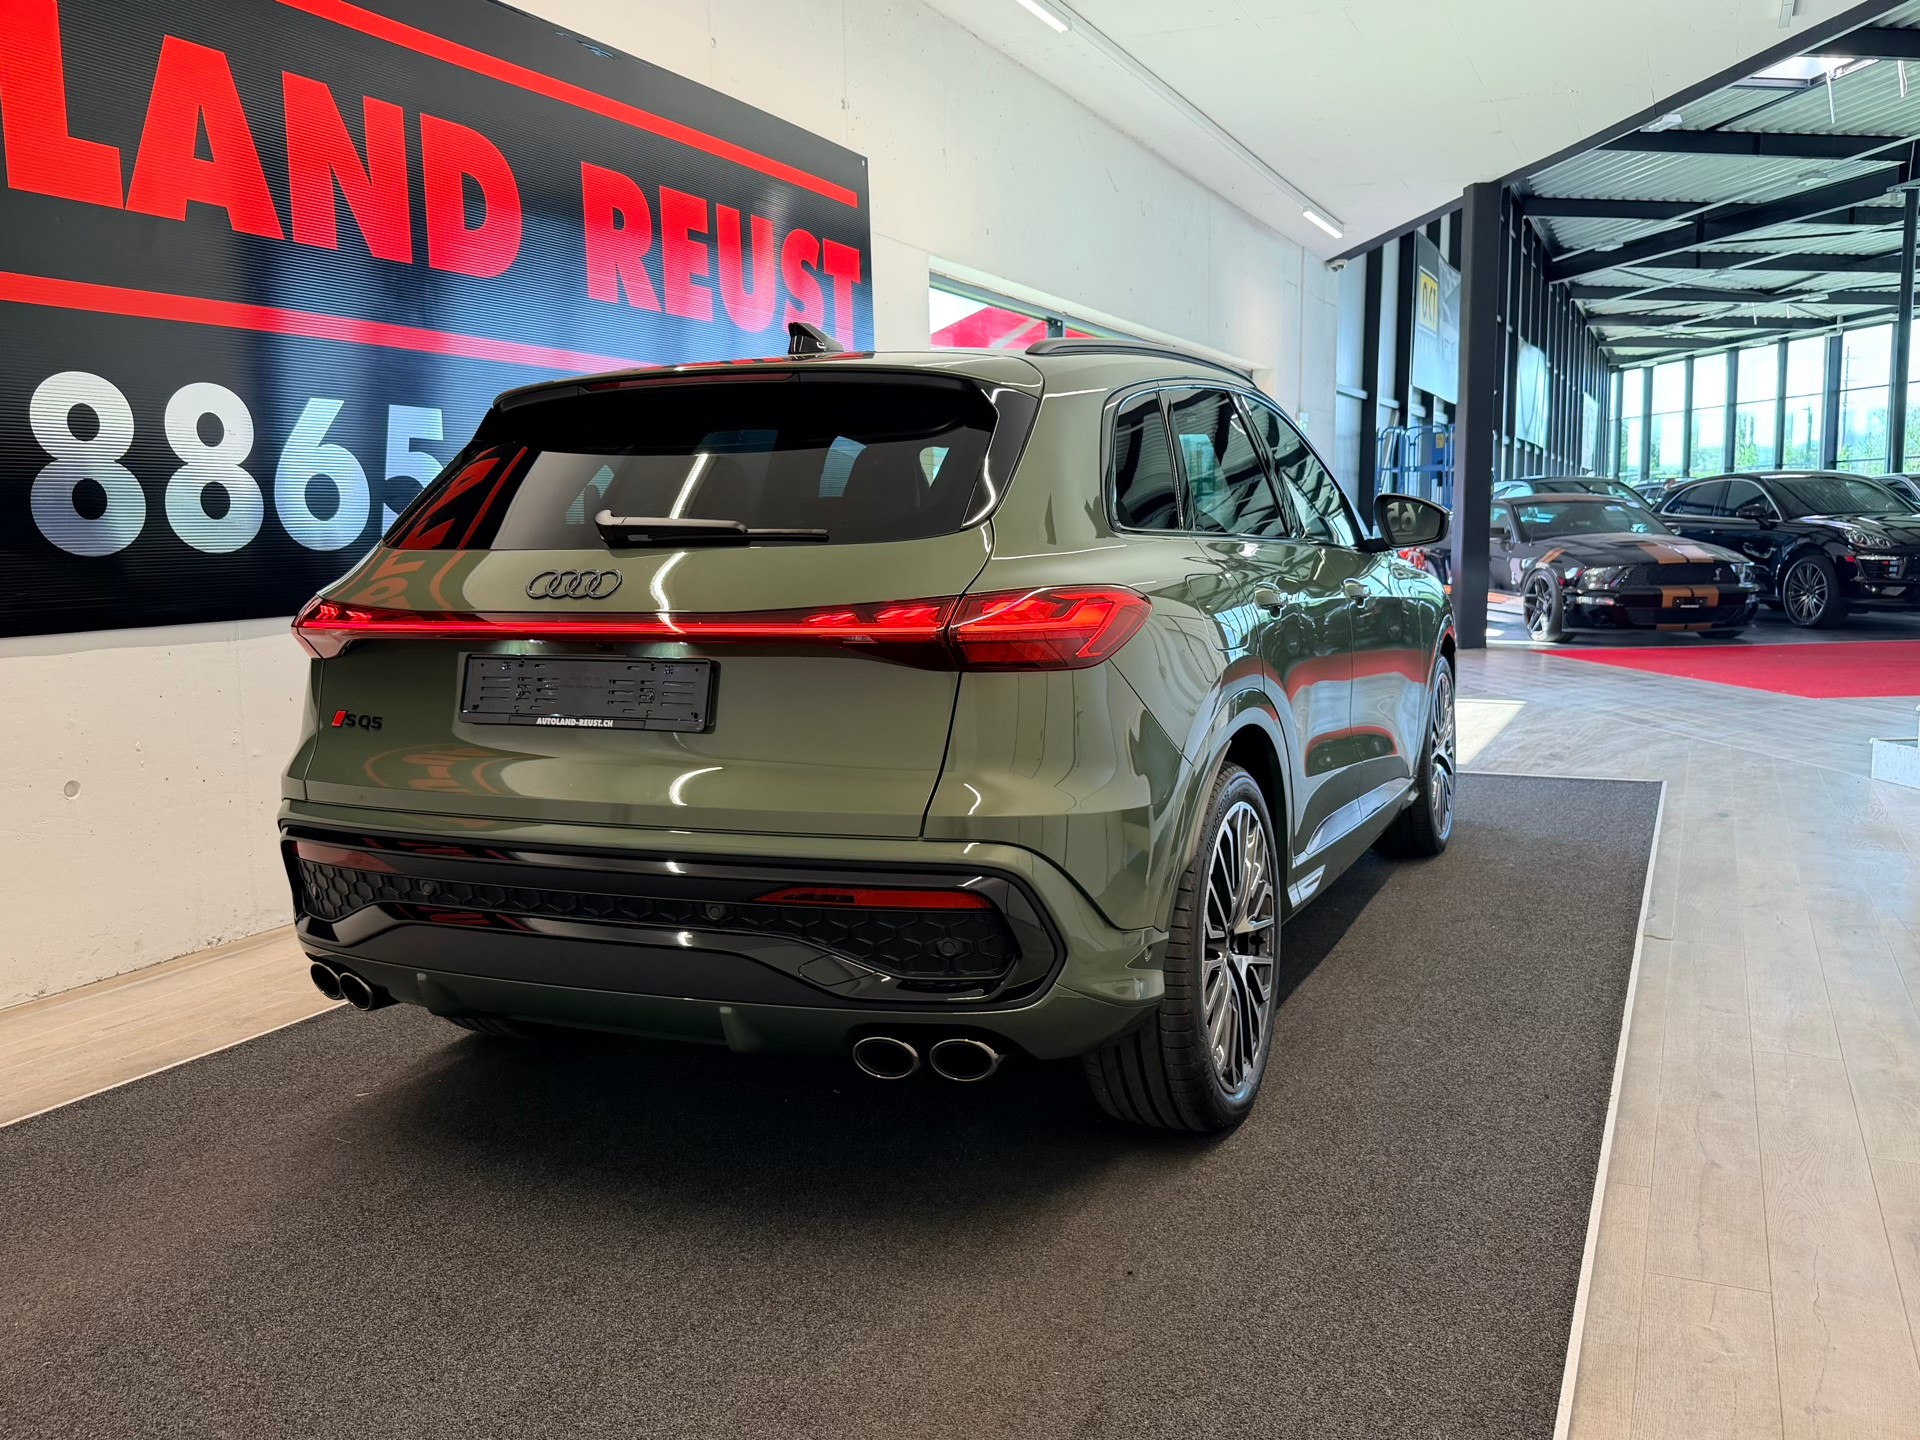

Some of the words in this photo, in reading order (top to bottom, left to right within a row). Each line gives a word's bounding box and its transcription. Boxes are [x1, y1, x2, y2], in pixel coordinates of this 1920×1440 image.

[580, 160, 861, 352] REUST
[29, 371, 444, 557] 8865
[345, 713, 383, 731] SQ5
[536, 716, 614, 728] AUTOLAND-REUST.CH
